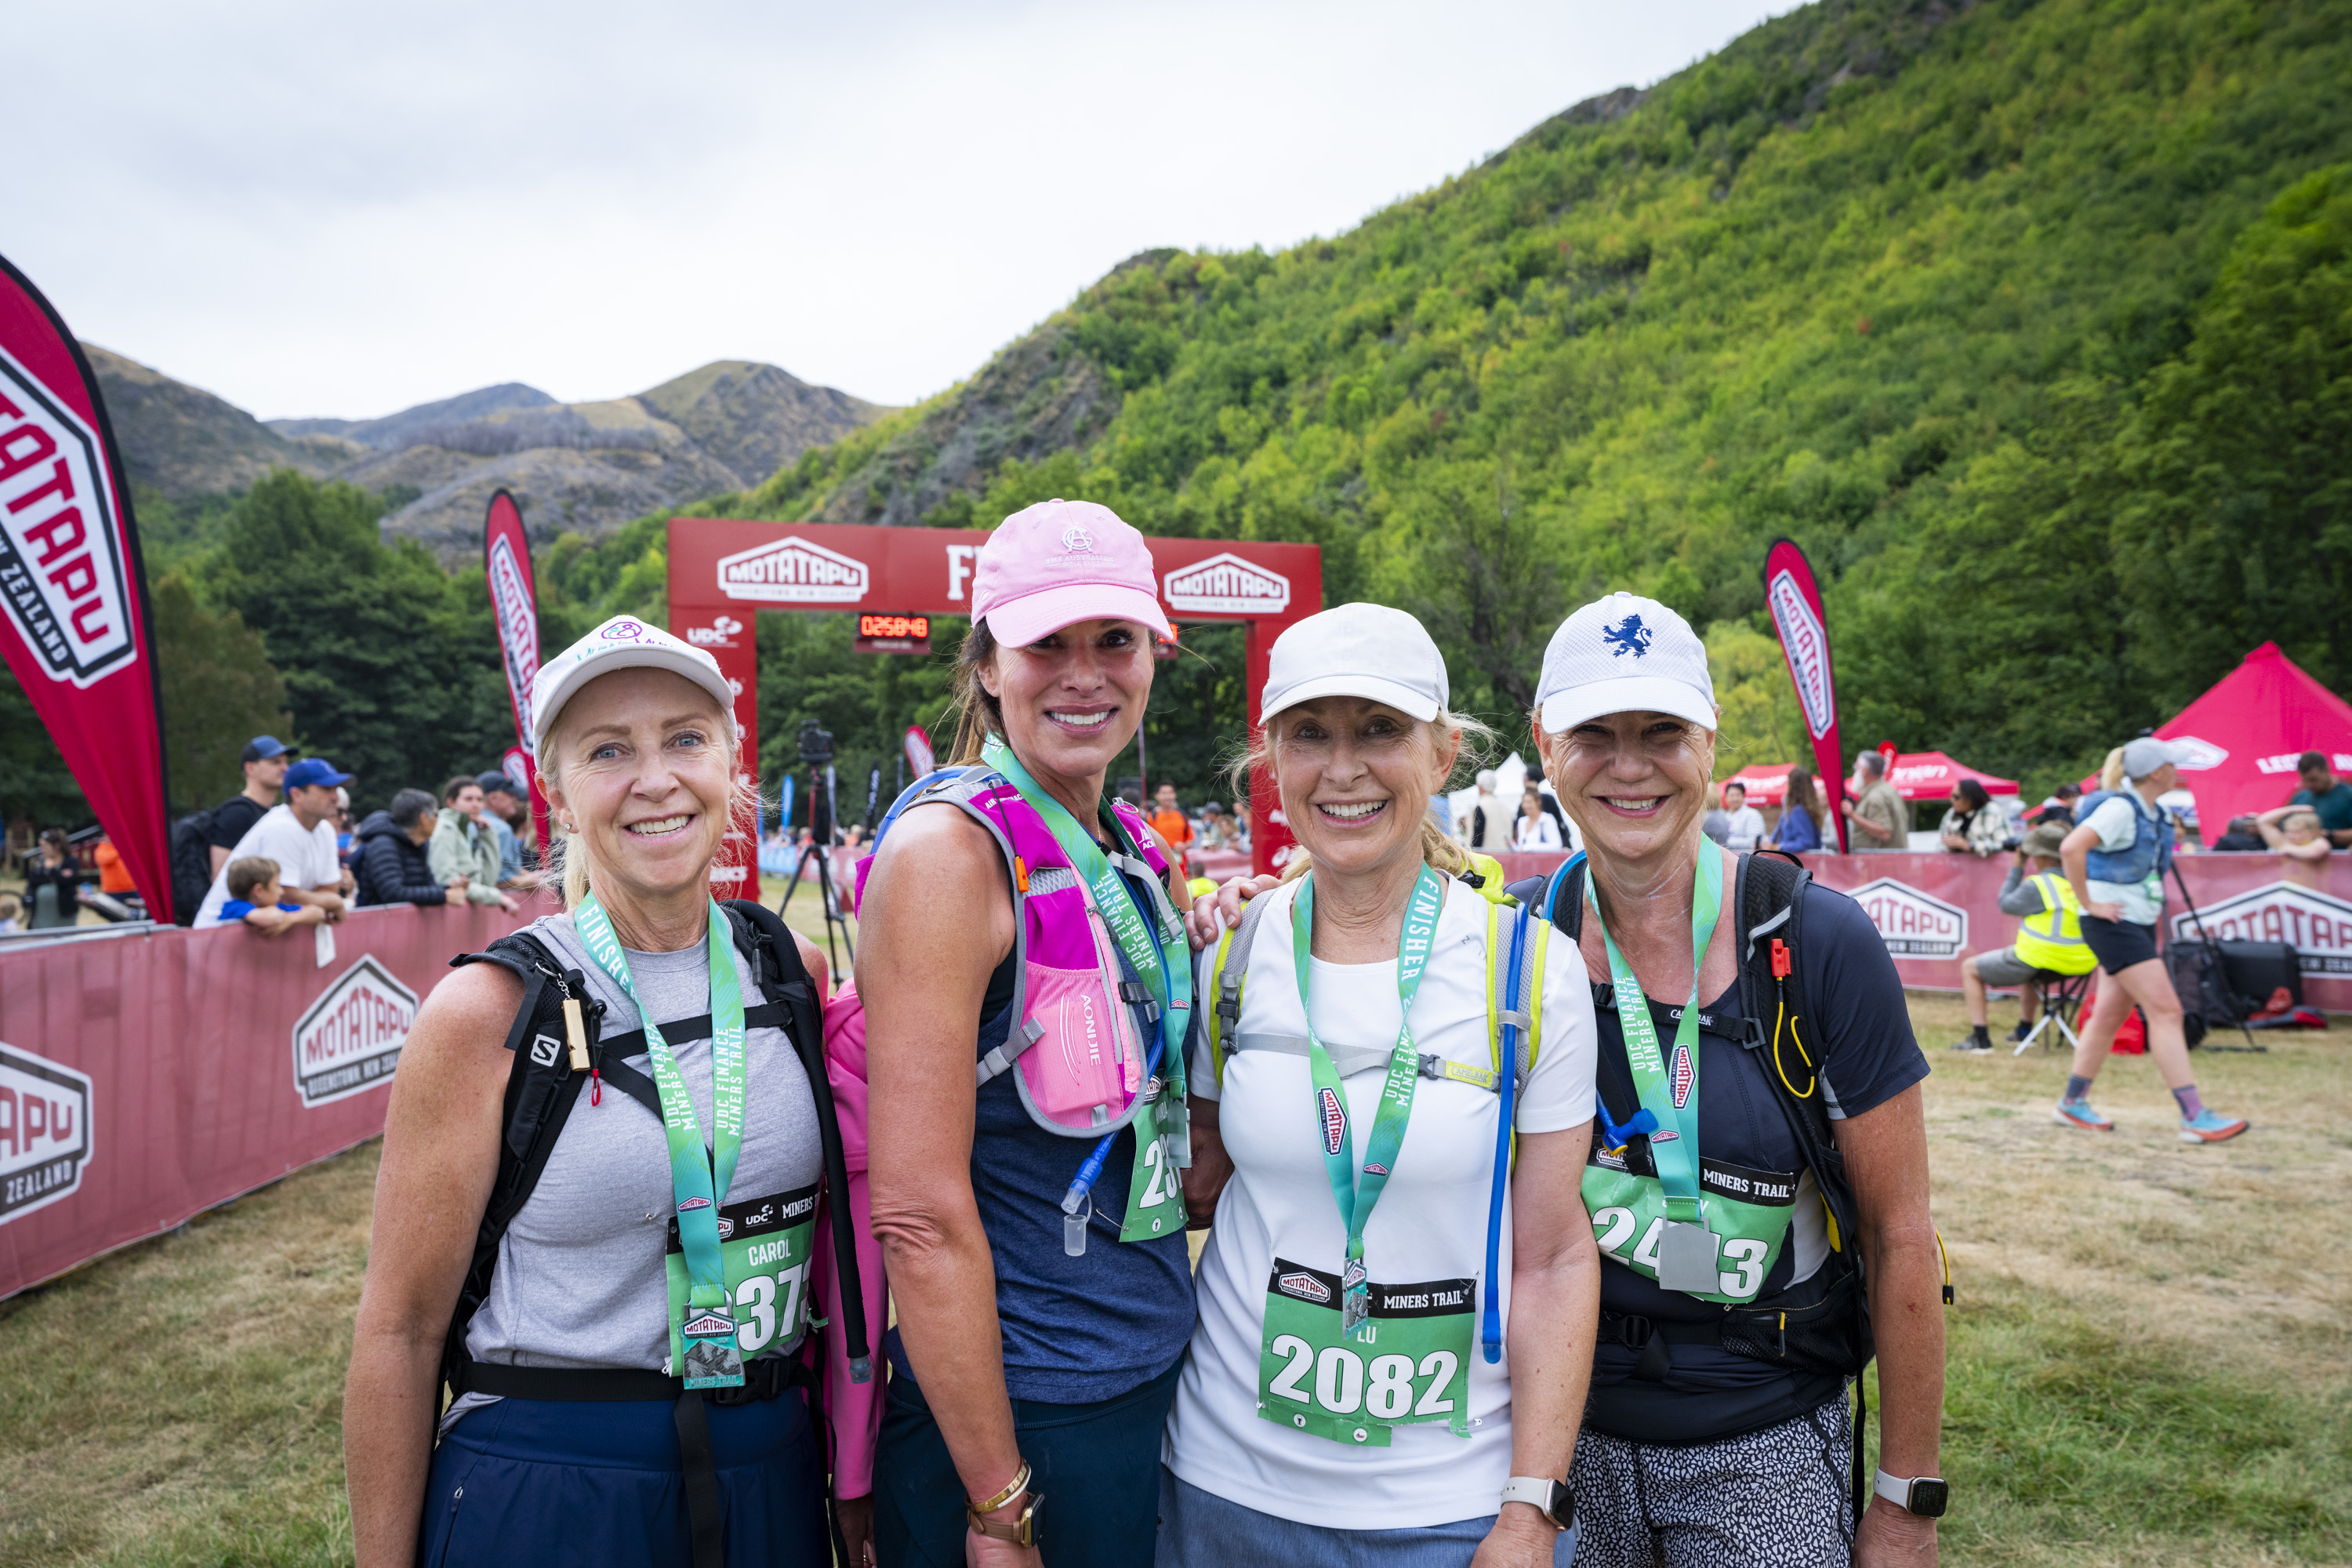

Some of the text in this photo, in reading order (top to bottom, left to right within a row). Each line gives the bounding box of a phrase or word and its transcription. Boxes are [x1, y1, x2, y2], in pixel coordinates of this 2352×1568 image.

[0, 390, 111, 644] ATAPU
[728, 548, 859, 586] MOTATAPU
[1172, 564, 1282, 598] MOTATAPU
[2, 557, 69, 664] ZEALAND
[1780, 587, 1824, 720] MOTATAPU
[985, 798, 997, 809] AIR
[1092, 882, 1147, 971] UDC FINANCE
[1102, 869, 1156, 970] MINERS TRAIL
[1401, 876, 1440, 982] FINISHER
[1861, 897, 1951, 935] ATAPU
[579, 903, 638, 1004] FINISHER
[307, 985, 411, 1065] MOTATAPU
[1080, 993, 1102, 1067] AONIJIE
[1616, 977, 1646, 1071] UDC FINANCE
[1627, 976, 1661, 1073] MINERS TRAIL
[1670, 1009, 1712, 1026] CABAK
[644, 1022, 682, 1129] UDC FINANCE
[649, 1022, 696, 1131] MINERS TRAIL
[716, 1027, 730, 1129] UDC FINANCE
[728, 1025, 743, 1137] MINERS TRAIL
[1385, 1071, 1404, 1098] UDC
[1396, 1048, 1417, 1107] MINERS
[1450, 1065, 1489, 1083] CAMELBAK
[1677, 1049, 1692, 1105] MOTATAPU
[1324, 1092, 1343, 1151] MOTATAPU
[1651, 1132, 1678, 1142] MOTATAPU
[6, 1160, 72, 1204] ZEALAND
[1364, 1164, 1388, 1174] MOTATAPU
[1703, 1168, 1790, 1198] MINERS TRAIL
[679, 1198, 710, 1210] MOTATAPU
[746, 1214, 768, 1225] UDC
[782, 1197, 813, 1218] MINERS
[748, 1239, 791, 1267] CAROL
[1347, 1269, 1365, 1285] MOTATAPU
[1592, 1207, 1769, 1298] 243
[1283, 1277, 1327, 1295] MOTATAPU
[1383, 1290, 1464, 1309] MINERS TRAIL
[686, 1319, 731, 1332] MOTATAPU
[1357, 1326, 1376, 1344] LU
[689, 1376, 739, 1388] MINERS TRAIL
[1269, 1334, 1458, 1419] 2082
